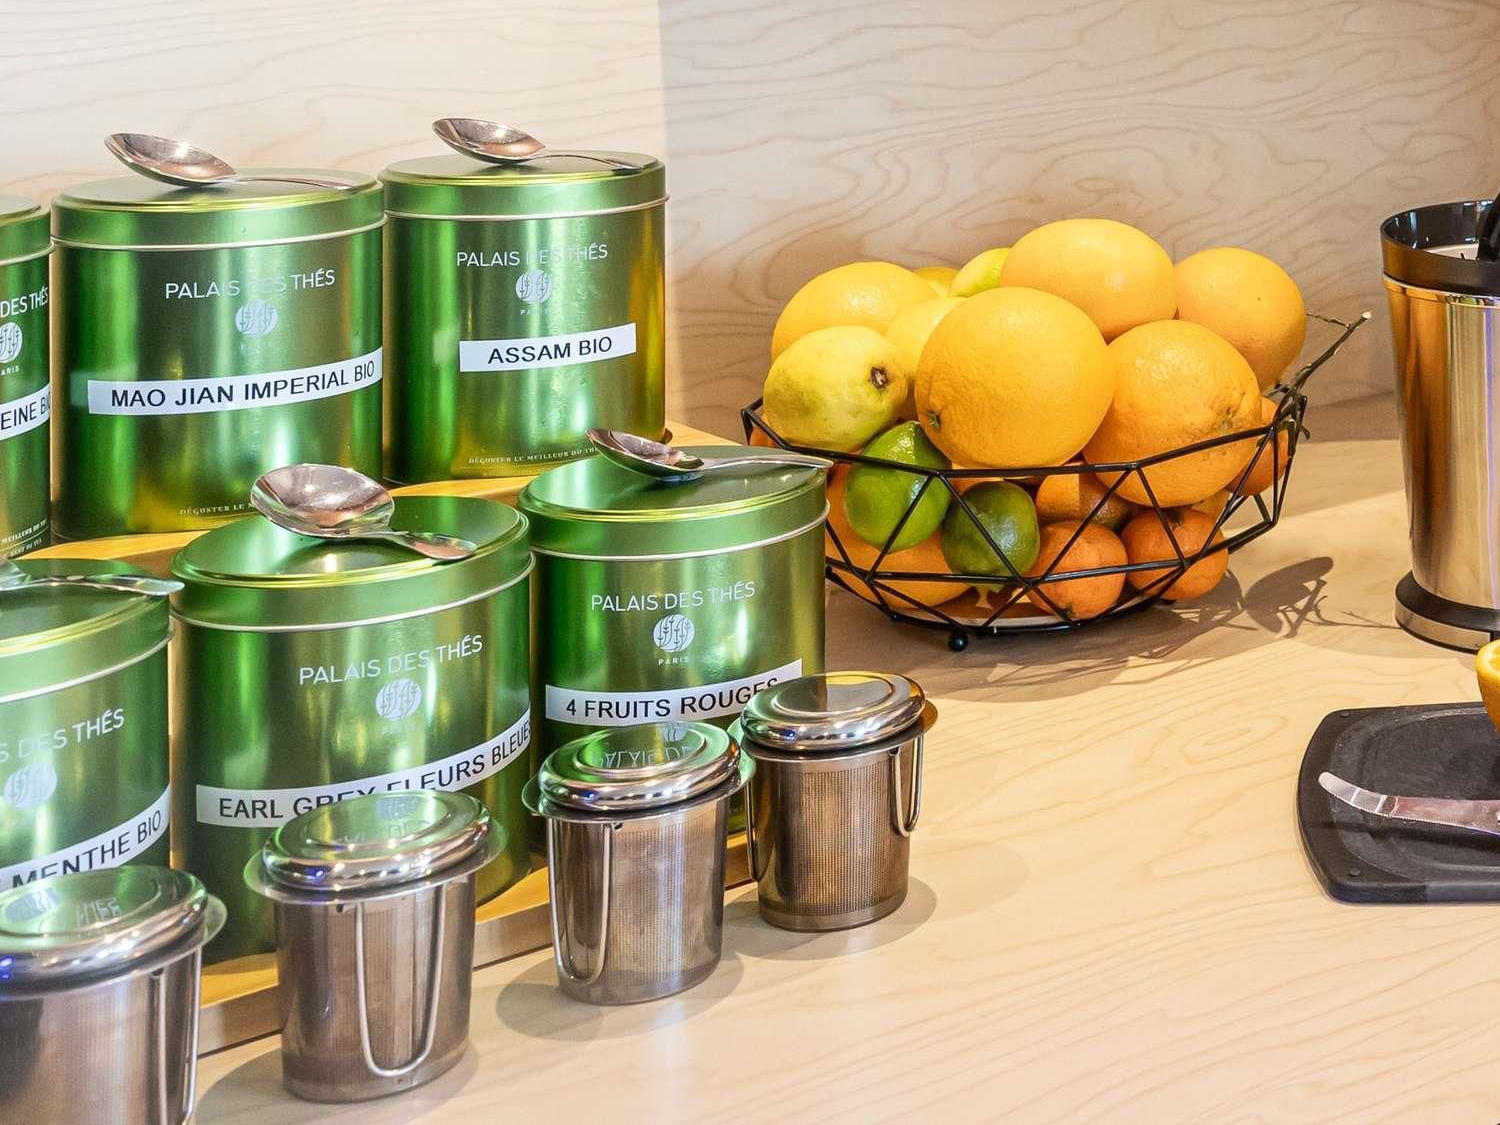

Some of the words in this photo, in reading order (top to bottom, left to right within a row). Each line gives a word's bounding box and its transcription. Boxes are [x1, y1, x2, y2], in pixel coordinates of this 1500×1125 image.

[457, 251, 520, 267] PALAIS
[165, 279, 240, 299] PALAIS
[291, 268, 335, 290] THÉS
[0, 296, 28, 318] DES
[487, 342, 571, 364] ASSAM
[579, 336, 612, 356] BIO
[111, 389, 166, 407] MAO
[175, 385, 234, 406] JIAN
[244, 369, 349, 401] IMPERIAL
[354, 360, 375, 383] BIO
[41, 392, 50, 415] BI
[591, 594, 659, 612] PALAIS
[664, 590, 704, 610] DES
[707, 581, 756, 605] THÉS
[299, 660, 381, 685] PALAIS
[388, 652, 431, 673] DES
[436, 635, 484, 663] THÉS
[566, 698, 576, 716] 4
[584, 698, 671, 719] FRUITS
[72, 708, 125, 743] THÉS
[219, 797, 284, 819] EARL
[492, 720, 531, 766] BLEUE
[138, 809, 162, 844] BIO
